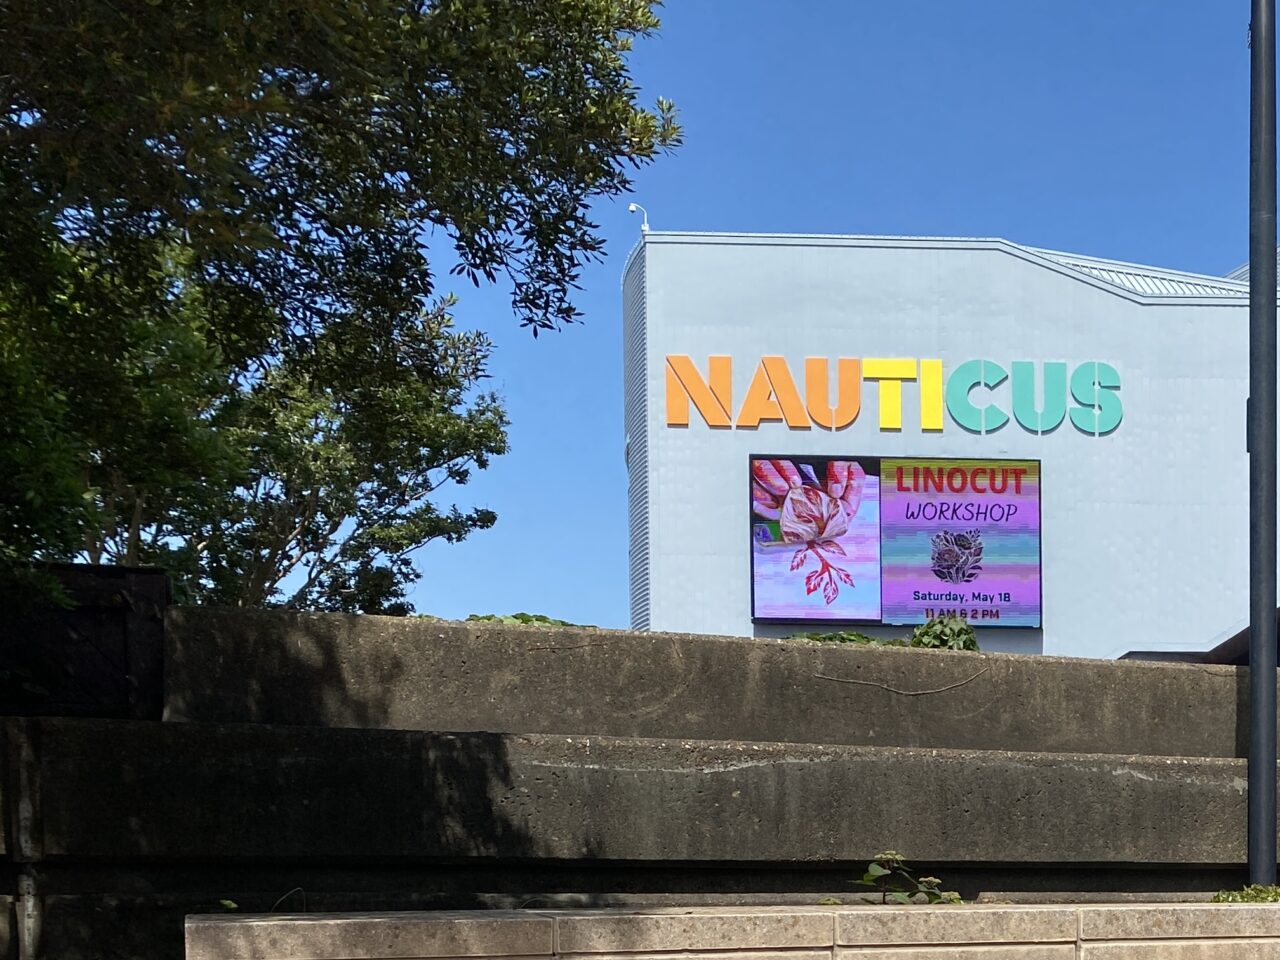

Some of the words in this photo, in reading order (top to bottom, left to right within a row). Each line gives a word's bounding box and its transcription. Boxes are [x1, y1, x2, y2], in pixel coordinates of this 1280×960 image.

[665, 355, 1124, 437] NAUTICUS
[896, 466, 1027, 494] LINOCUT
[905, 502, 1018, 522] WORKSHOP
[913, 590, 968, 604] Saturday,
[972, 592, 995, 604] May
[998, 592, 1011, 602] 18
[925, 608, 935, 619] 11
[938, 608, 957, 619] AM
[970, 609, 978, 619] 2
[982, 609, 1000, 619] PM
